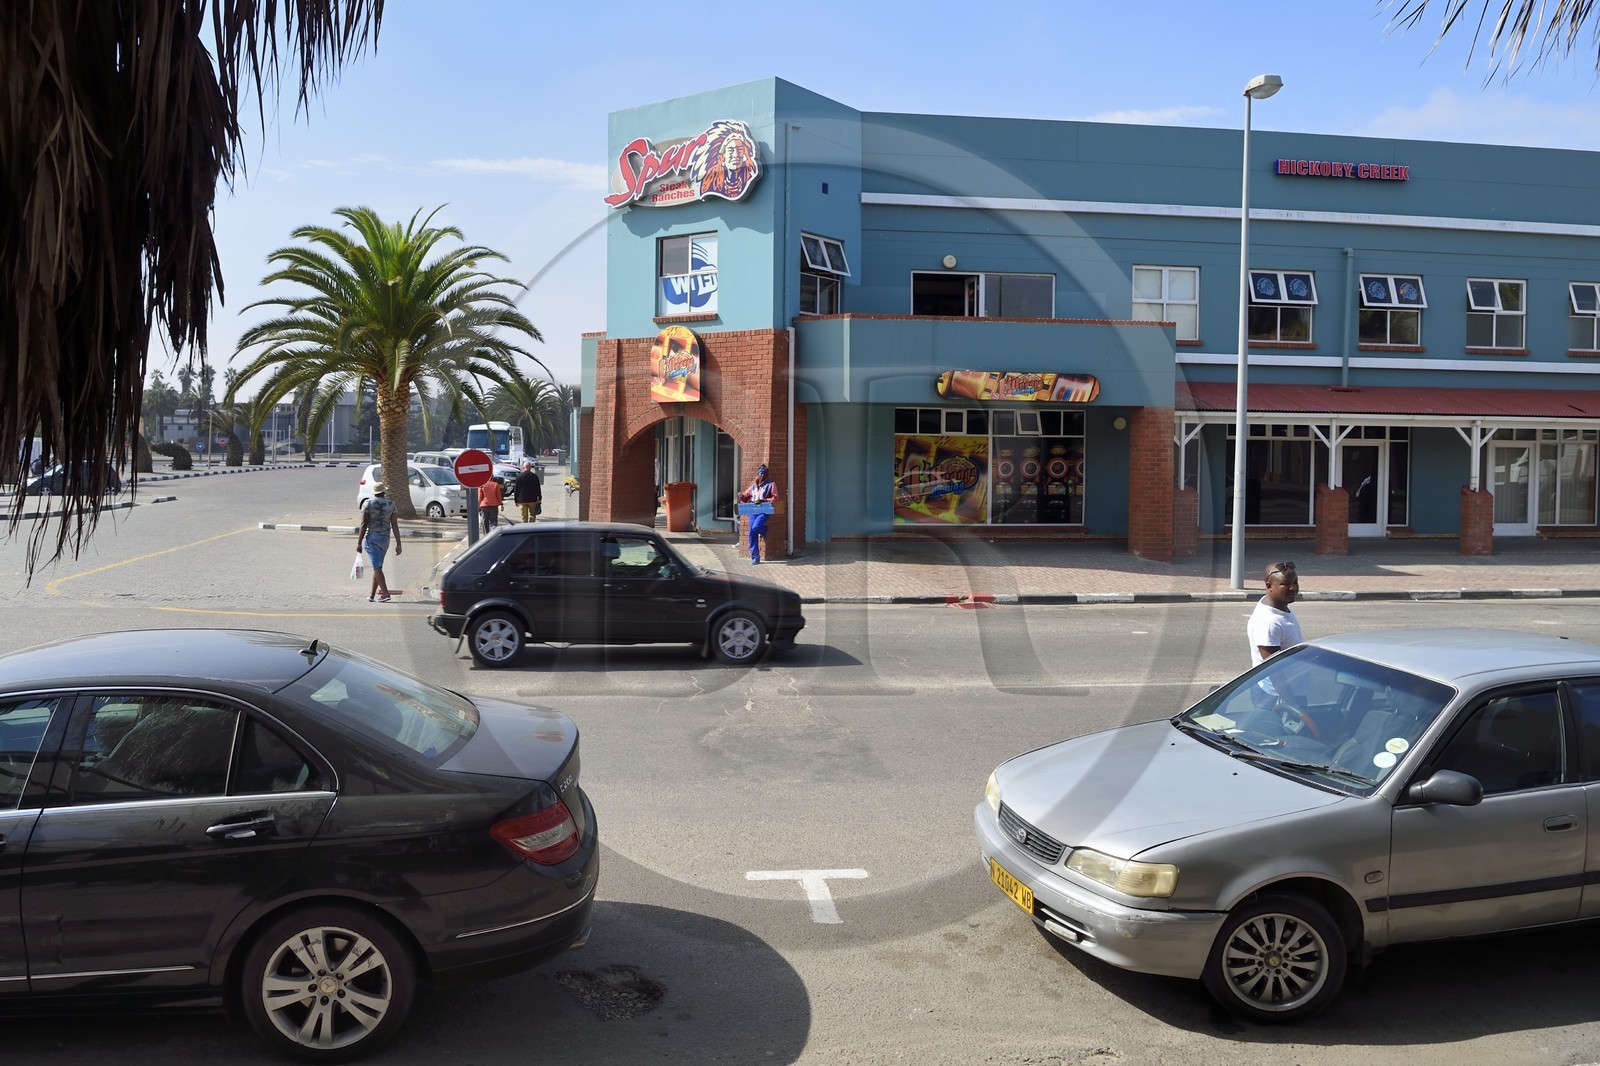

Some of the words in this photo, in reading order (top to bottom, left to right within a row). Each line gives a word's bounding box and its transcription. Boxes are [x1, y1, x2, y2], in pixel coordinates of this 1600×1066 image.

[603, 137, 708, 208] Spur
[1277, 159, 1353, 178] HICKORY
[1356, 163, 1410, 181] CREEK
[651, 188, 696, 203] Ranches
[659, 180, 689, 193] Steak
[996, 867, 1019, 901] 21042
[1021, 887, 1032, 911] WB
